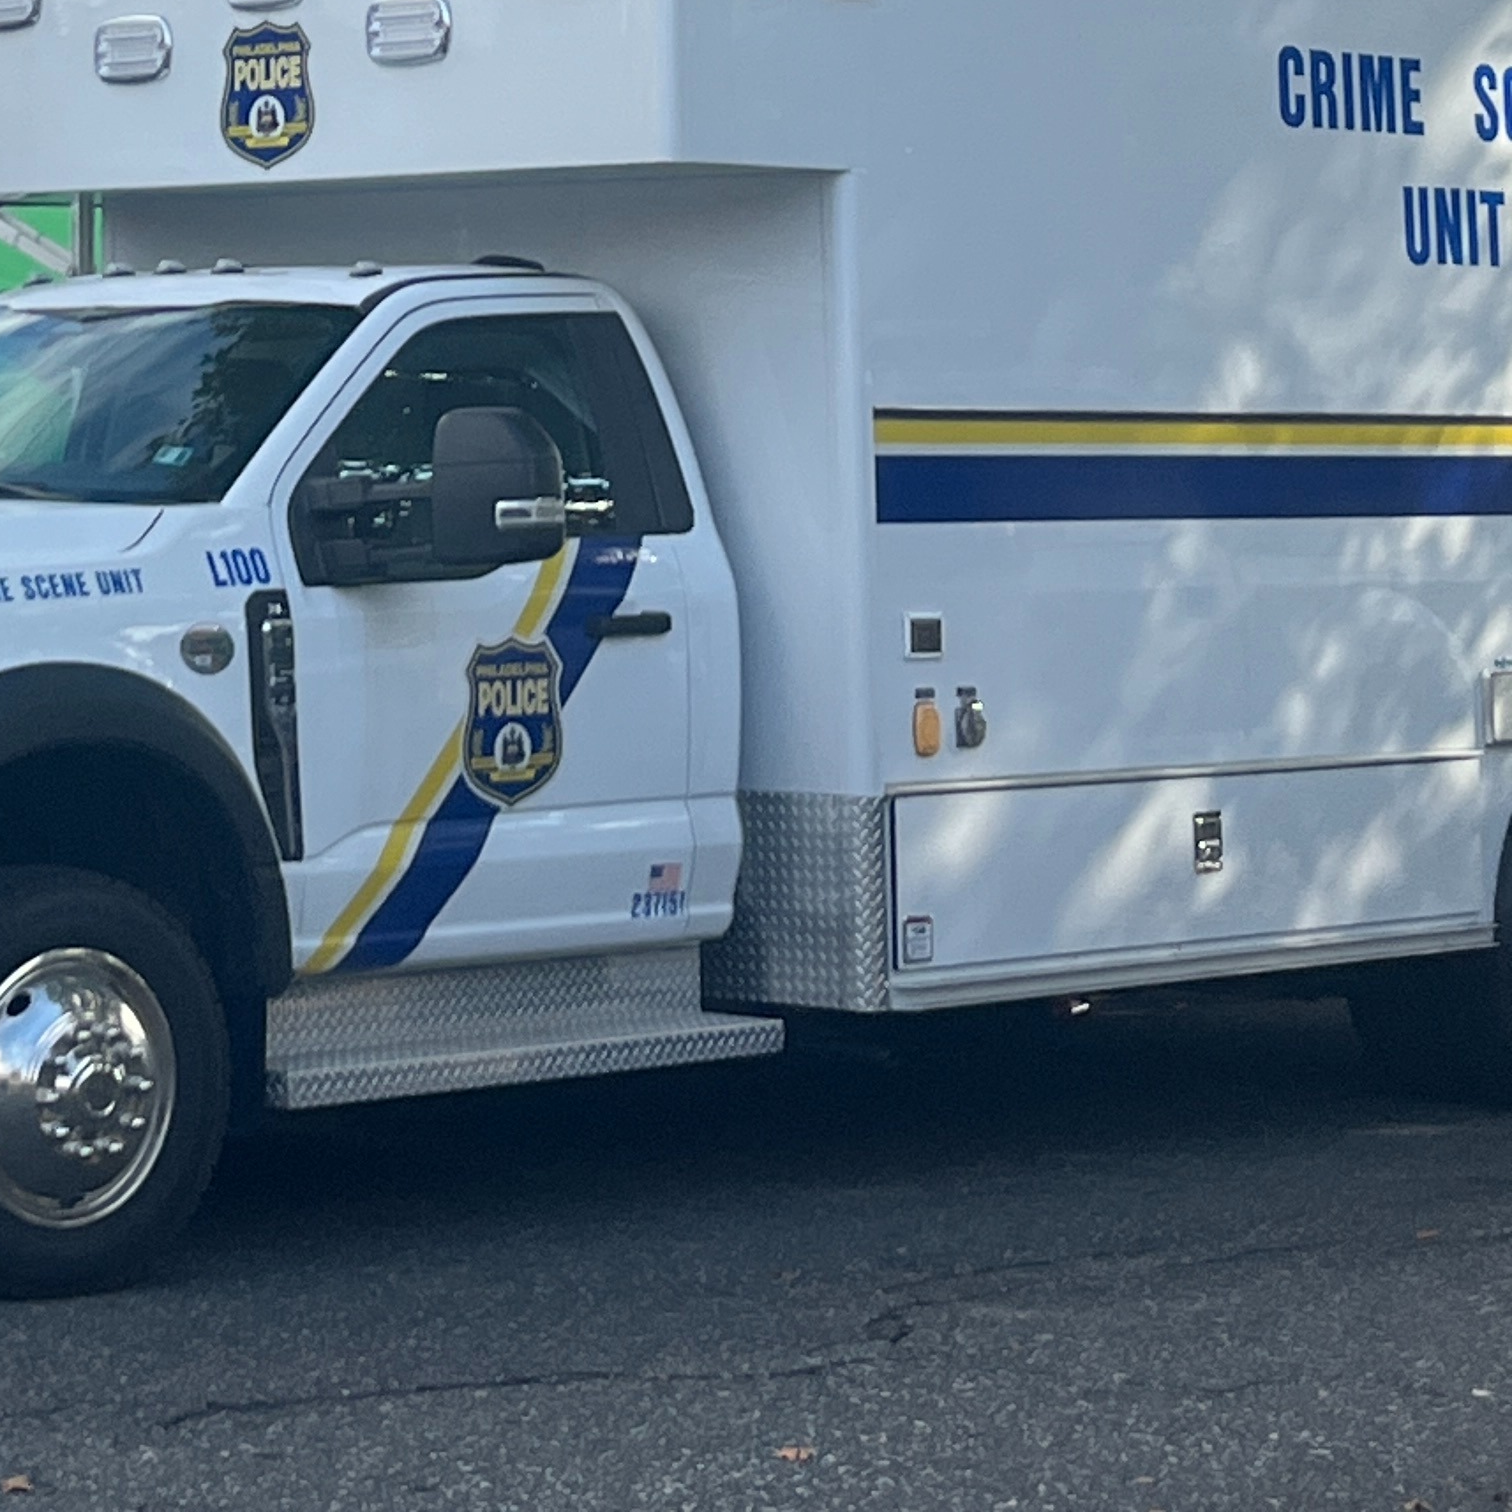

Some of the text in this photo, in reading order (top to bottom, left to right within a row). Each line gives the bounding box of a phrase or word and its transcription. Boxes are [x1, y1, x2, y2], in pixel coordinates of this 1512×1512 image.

[234, 55, 302, 91] POLICE
[1278, 45, 1425, 135] CRIME
[1402, 186, 1505, 267] UNIT
[20, 570, 91, 602] SCENE
[95, 567, 145, 595] UNIT
[206, 547, 272, 588] L100
[477, 678, 550, 718] POLICE
[630, 890, 686, 918] 237151
